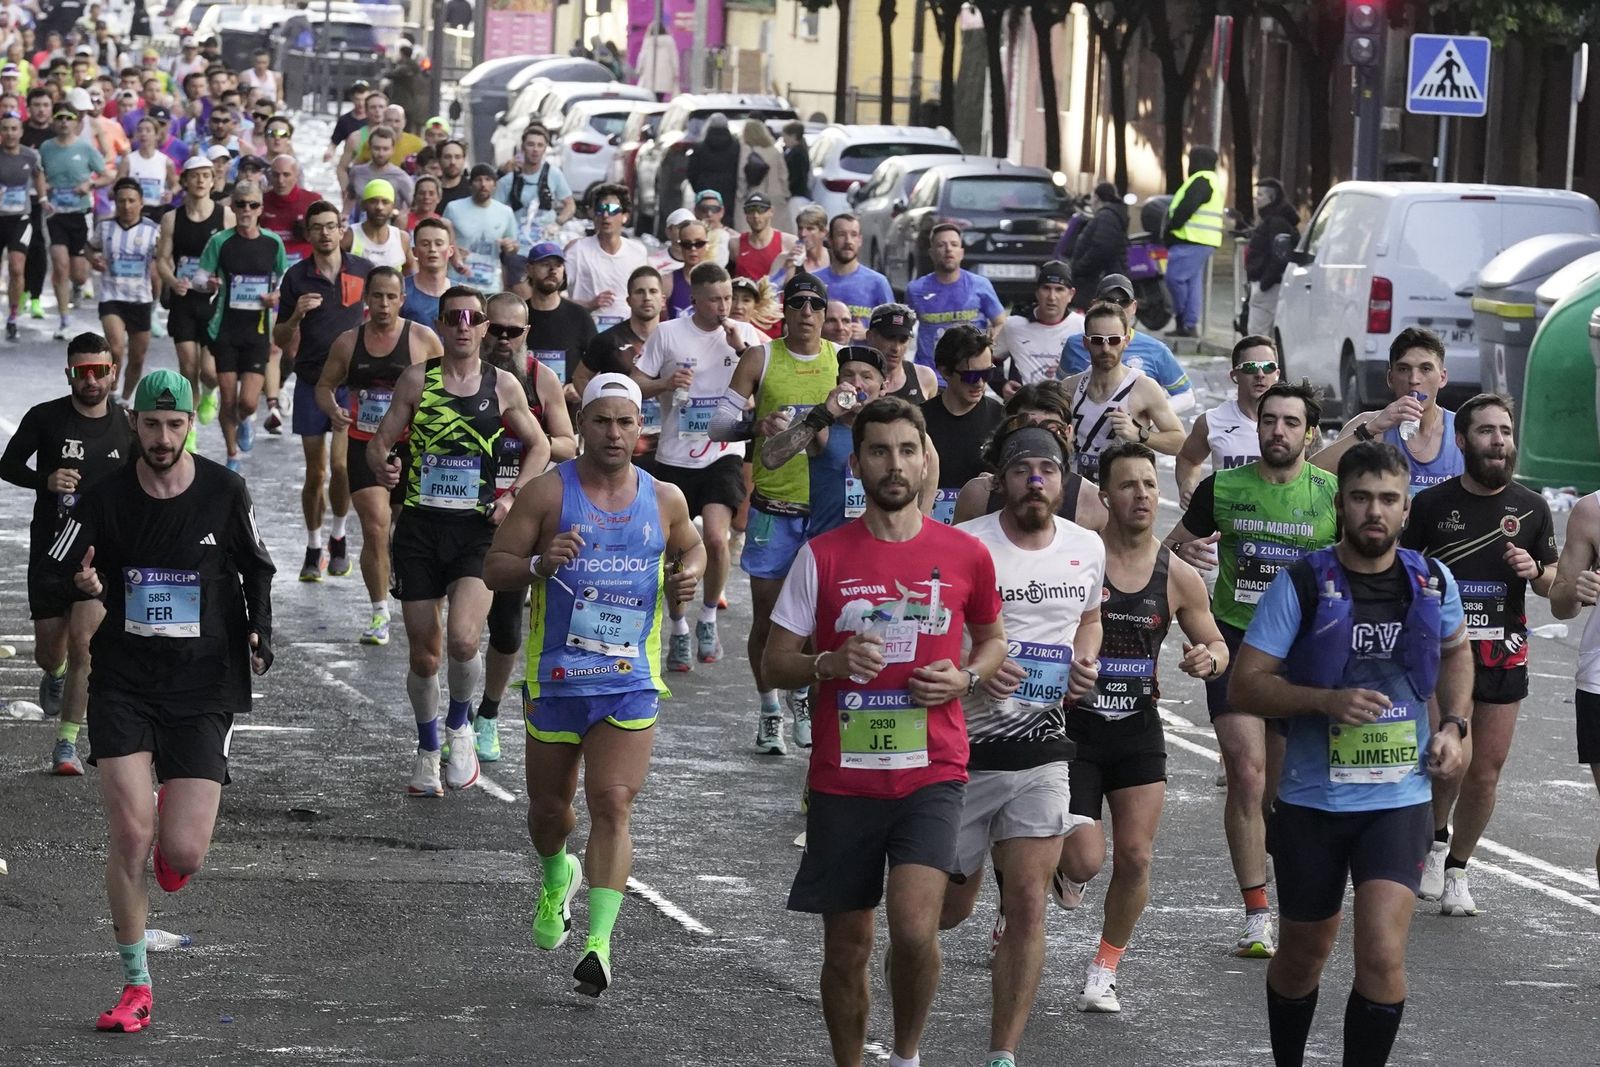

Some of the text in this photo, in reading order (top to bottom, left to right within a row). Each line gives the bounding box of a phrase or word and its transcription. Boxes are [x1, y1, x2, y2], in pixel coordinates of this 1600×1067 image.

[1452, 330, 1475, 342] MFY
[688, 422, 709, 430] PAW
[440, 459, 473, 467] ZURICH
[1311, 474, 1326, 485] 2023
[431, 484, 467, 496] FRANK
[1230, 504, 1256, 512] HOKA
[1234, 518, 1314, 537] MEDIO MARATÓN
[1260, 546, 1300, 557] ZURICH
[147, 572, 190, 582] ZURICH
[840, 585, 886, 596] KIPRUN
[148, 592, 171, 602] 5853
[1464, 602, 1483, 611] 3836
[146, 606, 172, 621] FER
[600, 612, 622, 624] 9729
[592, 624, 622, 638] JOSE
[1352, 622, 1402, 652] CV
[1025, 646, 1064, 660] ZURICH
[568, 666, 610, 677] SimaGol
[1106, 663, 1146, 672] ZURICH
[1106, 682, 1128, 692] 4223
[1093, 694, 1138, 710] JUAKY
[870, 718, 896, 730] 2930
[870, 734, 898, 750] J.E.
[1362, 732, 1388, 744] 3106
[1331, 746, 1418, 765] A. JIMENEZ
